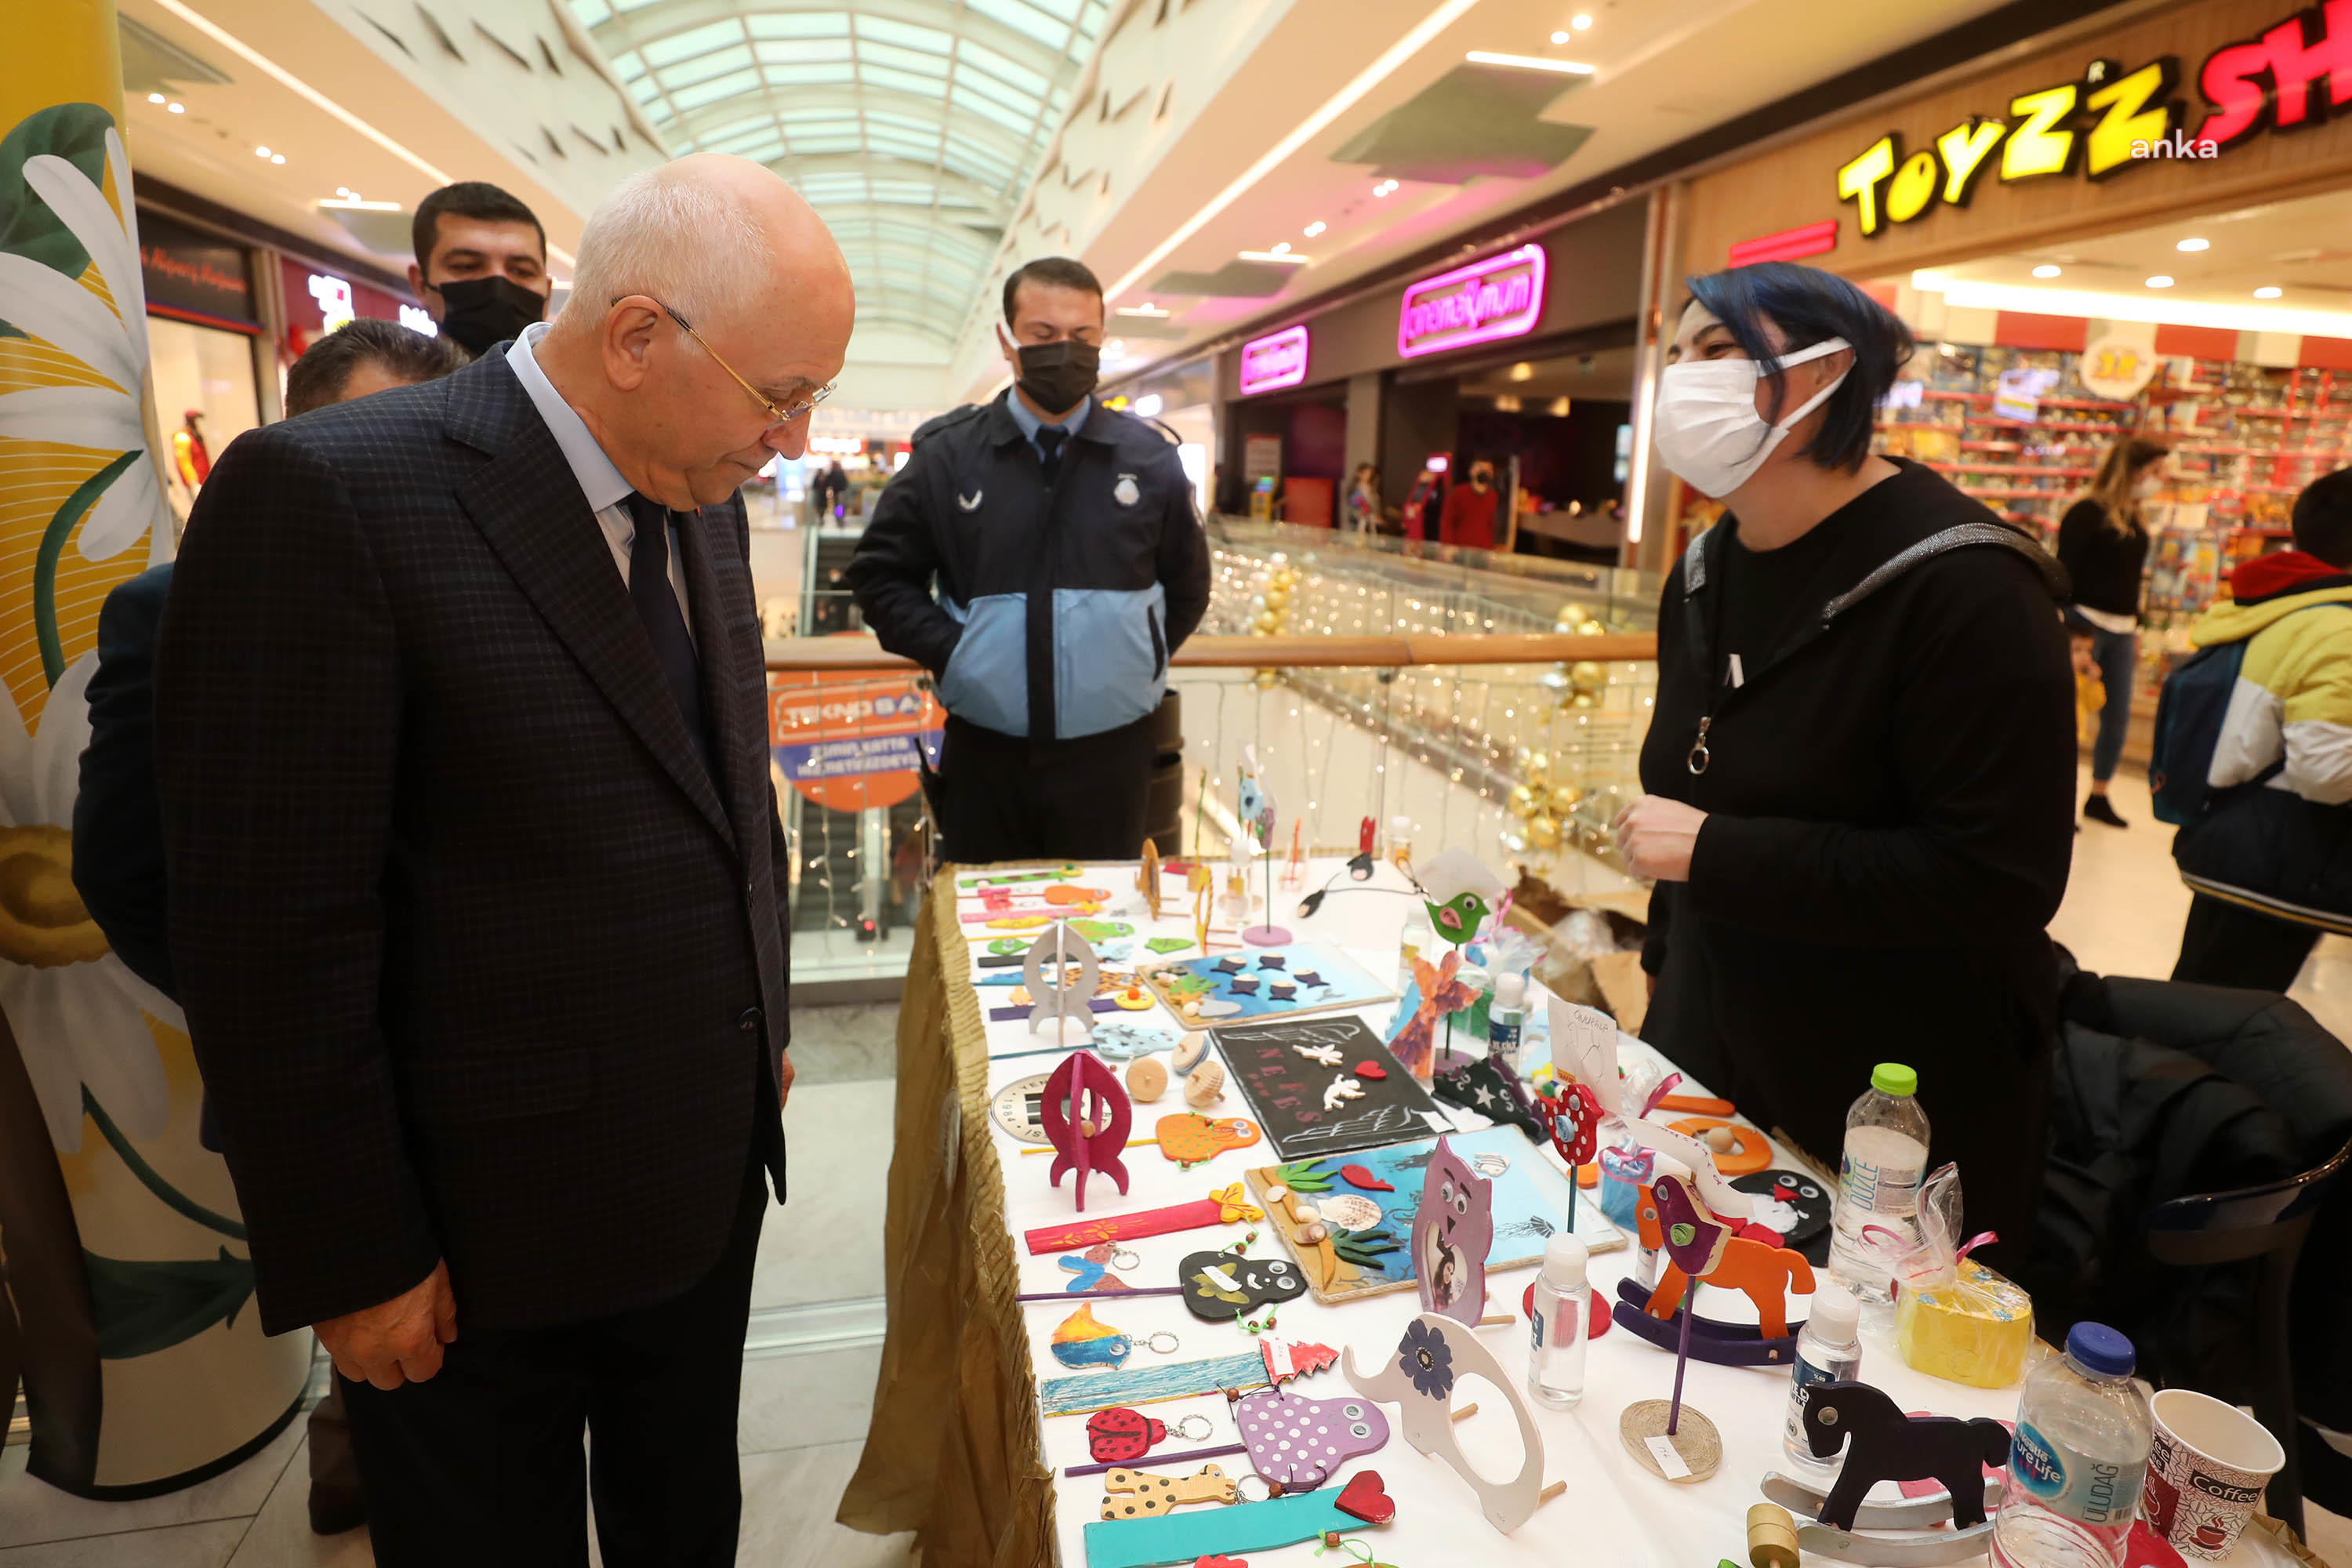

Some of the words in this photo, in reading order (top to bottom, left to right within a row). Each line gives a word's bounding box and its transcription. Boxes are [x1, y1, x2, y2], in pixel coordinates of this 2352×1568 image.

[2035, 1458, 2061, 1483] Life
[2085, 1463, 2119, 1523] ULUDAĞ
[2193, 1475, 2258, 1503] Coffee
